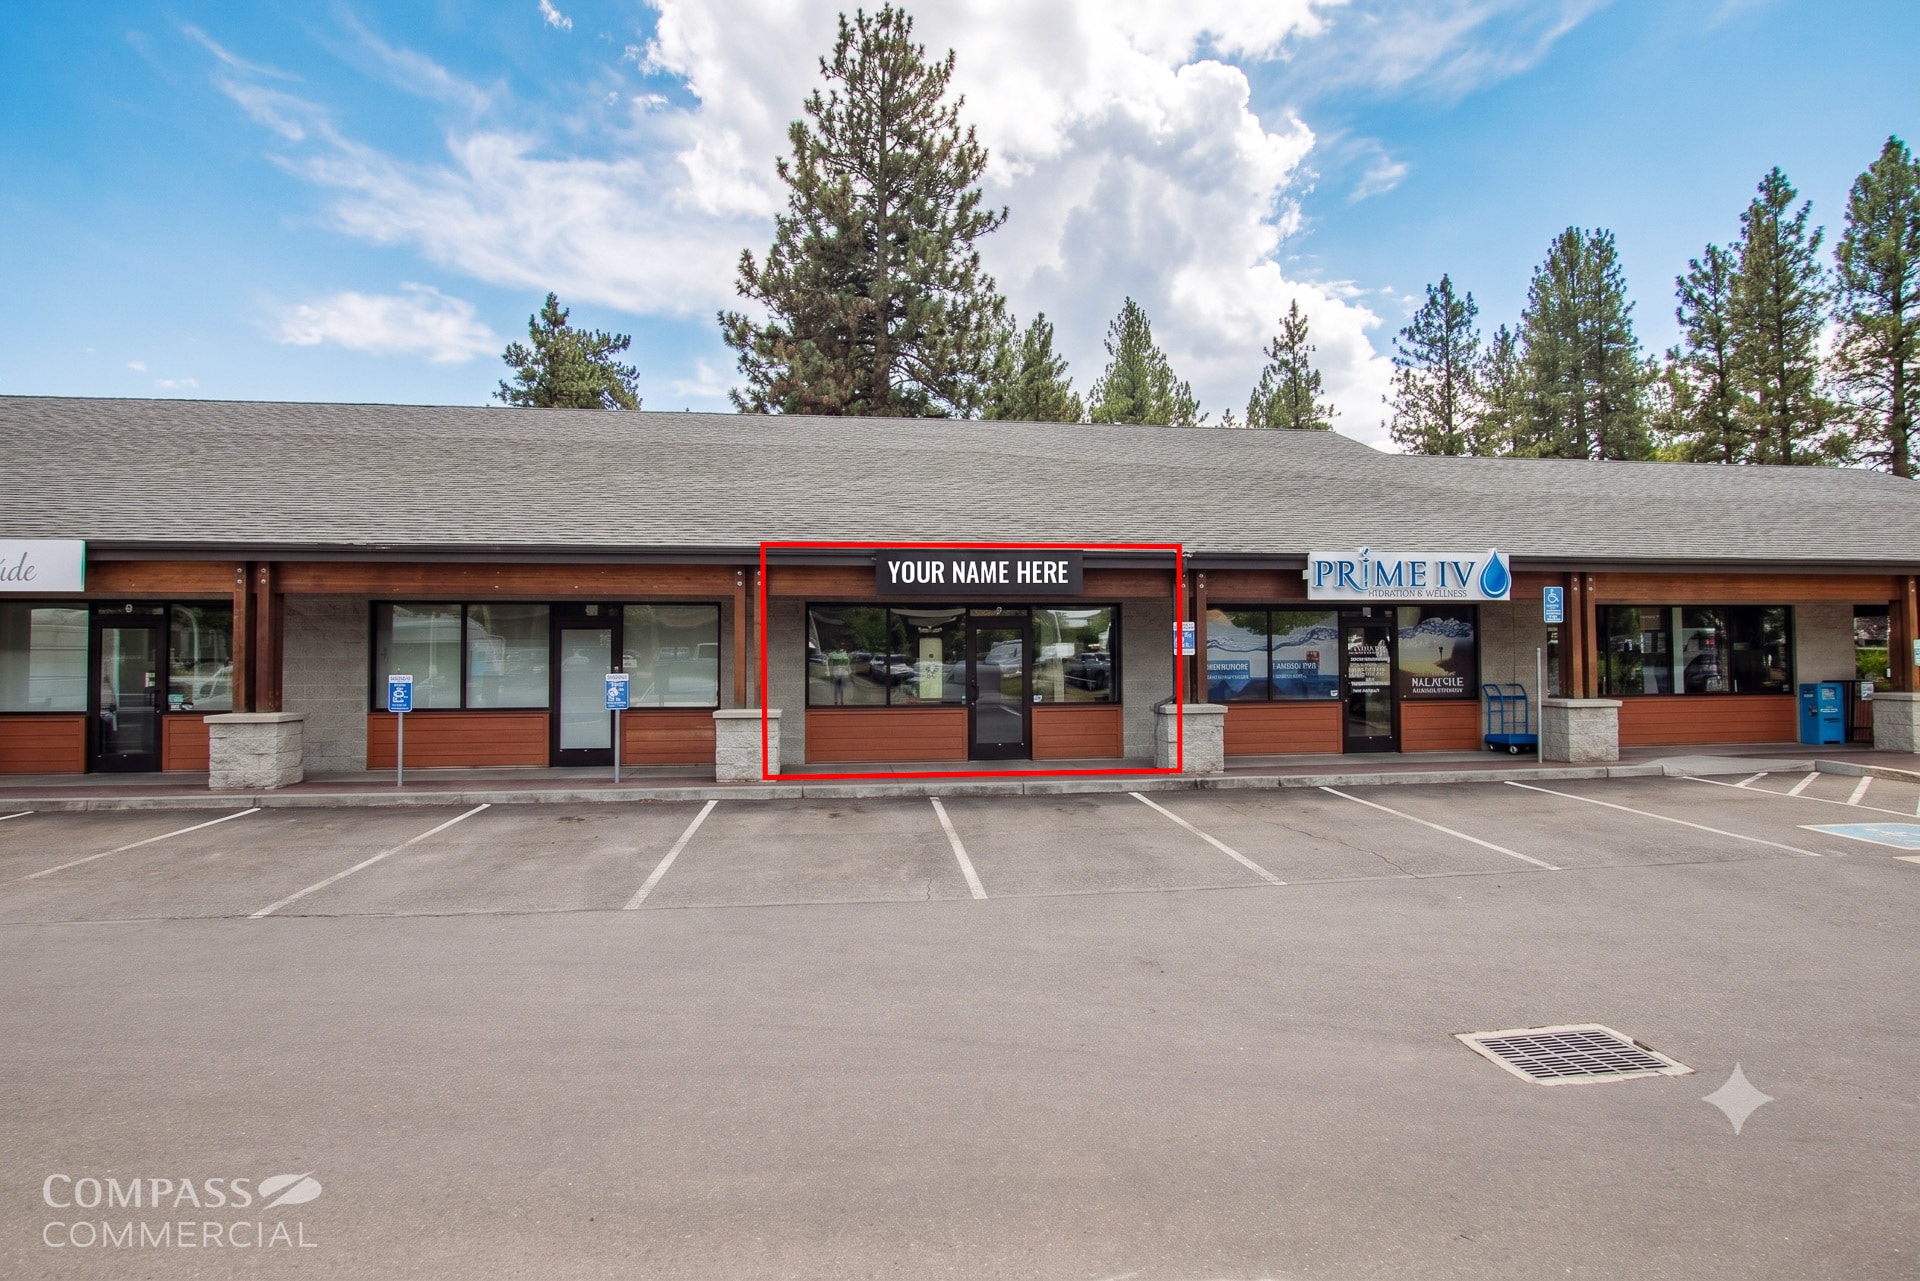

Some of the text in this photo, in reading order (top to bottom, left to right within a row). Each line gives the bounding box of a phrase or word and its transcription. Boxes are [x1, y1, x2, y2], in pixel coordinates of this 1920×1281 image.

[887, 560, 1069, 584] YOUR NAME HERE
[1438, 560, 1476, 588] IV
[1368, 589, 1416, 598] HYDRATION
[1426, 589, 1467, 598] WELLNESS
